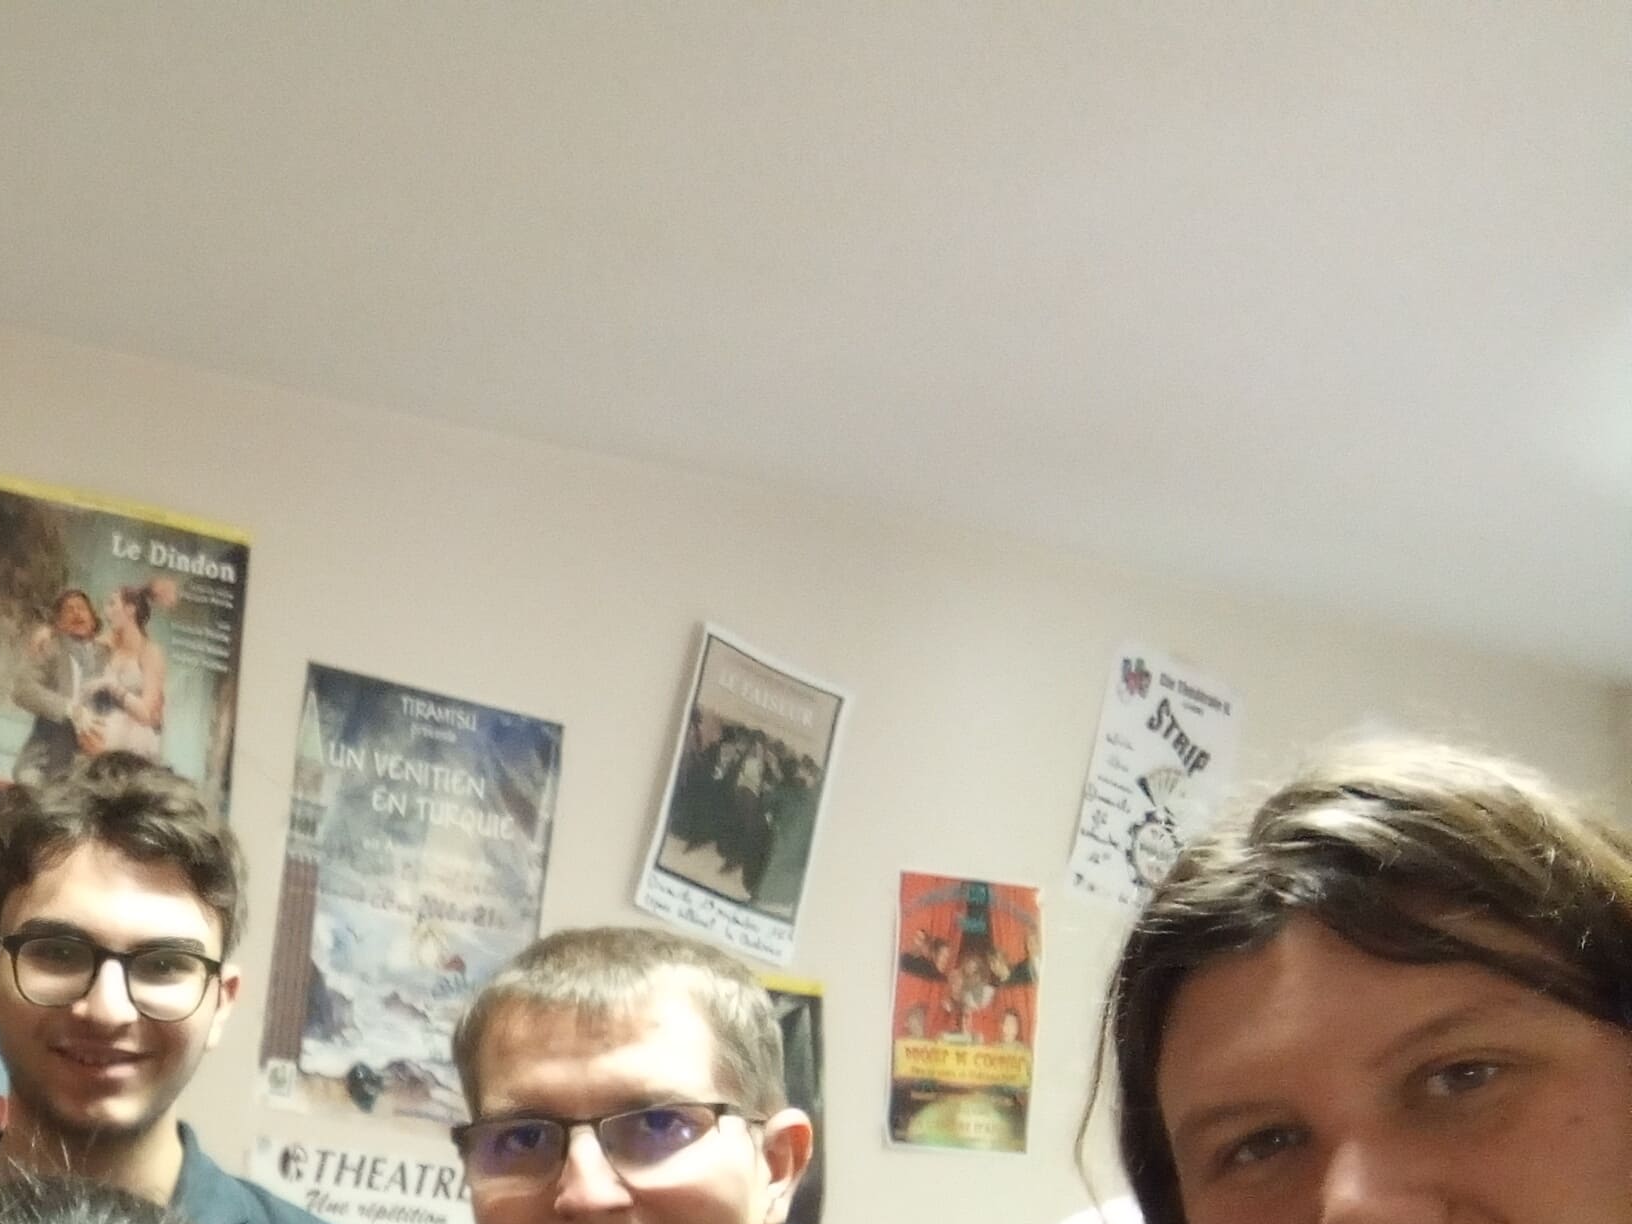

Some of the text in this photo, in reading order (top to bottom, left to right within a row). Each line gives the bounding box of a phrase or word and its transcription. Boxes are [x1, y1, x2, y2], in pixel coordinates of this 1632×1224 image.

[112, 534, 236, 583] Le Dindon
[402, 696, 477, 729] TIRAMISU
[329, 742, 366, 771] UN
[1146, 697, 1211, 777] STRIP
[372, 787, 516, 841] EN TURQUIE
[305, 1188, 349, 1215] Une
